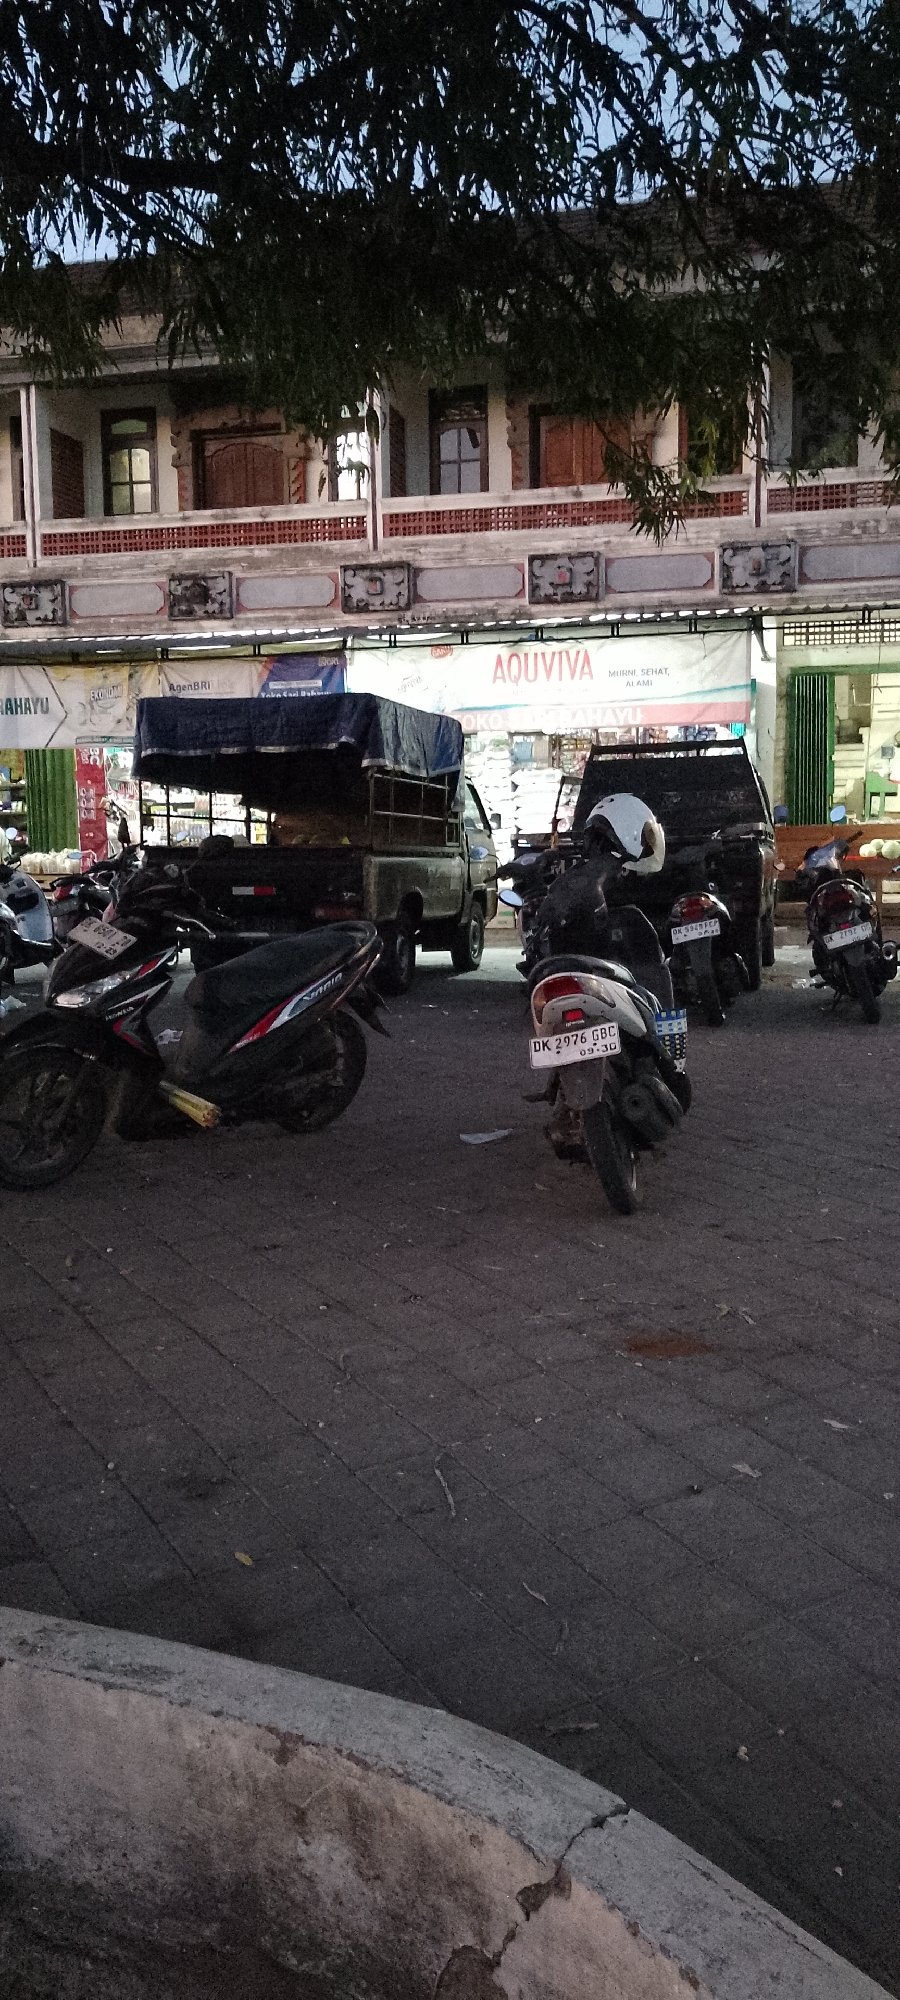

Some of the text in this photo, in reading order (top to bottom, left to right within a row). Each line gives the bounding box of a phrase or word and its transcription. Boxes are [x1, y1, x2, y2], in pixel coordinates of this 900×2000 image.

[493, 649, 594, 686] AQUVIVA
[608, 667, 670, 678] MURNI, SEHAT,
[626, 680, 653, 688] ALAMI
[559, 708, 642, 728] RAHAYU
[533, 1025, 617, 1053] DK 2976 GBC
